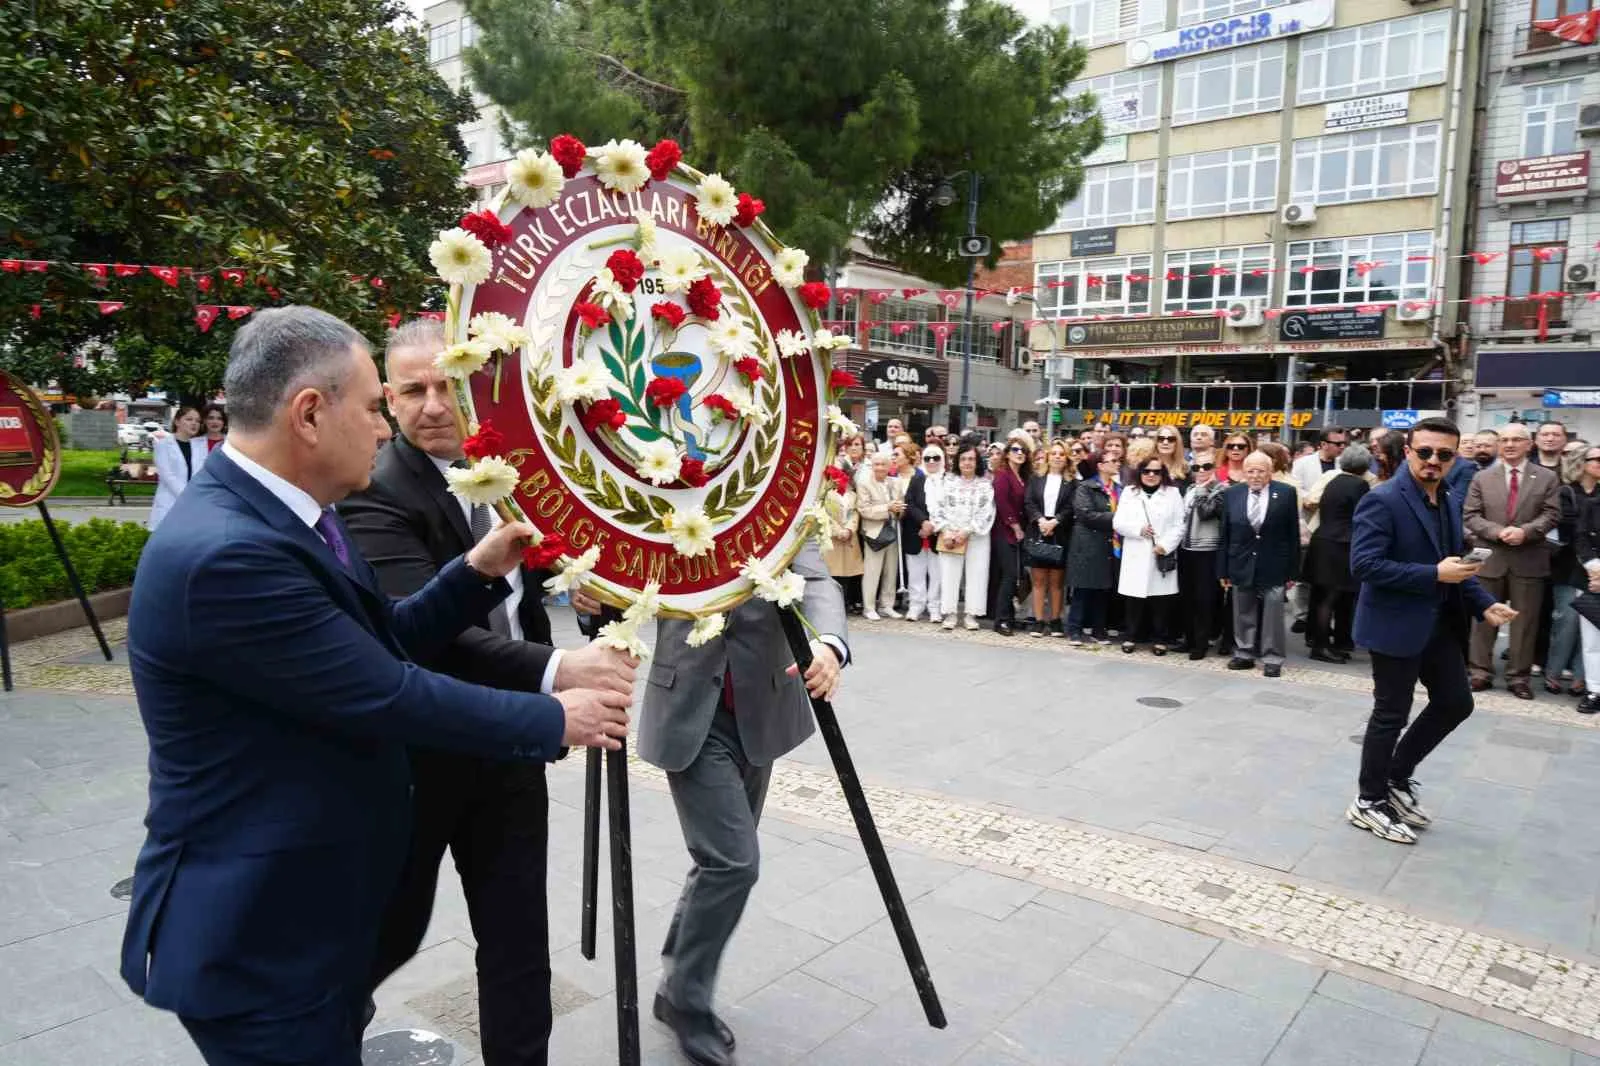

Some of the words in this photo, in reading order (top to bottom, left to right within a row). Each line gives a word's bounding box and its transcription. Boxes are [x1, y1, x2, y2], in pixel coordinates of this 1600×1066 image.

[495, 217, 559, 293] TÜRK
[548, 187, 687, 236] ECZACILARI
[638, 278, 665, 295] 195
[886, 365, 920, 383] OBA
[1137, 411, 1189, 426] TERME
[1230, 412, 1253, 426] VE
[520, 468, 611, 550] BÖLGE
[613, 539, 720, 585] SAMSUN
[722, 495, 789, 569] ECZACI
[778, 418, 813, 500] ODASI
